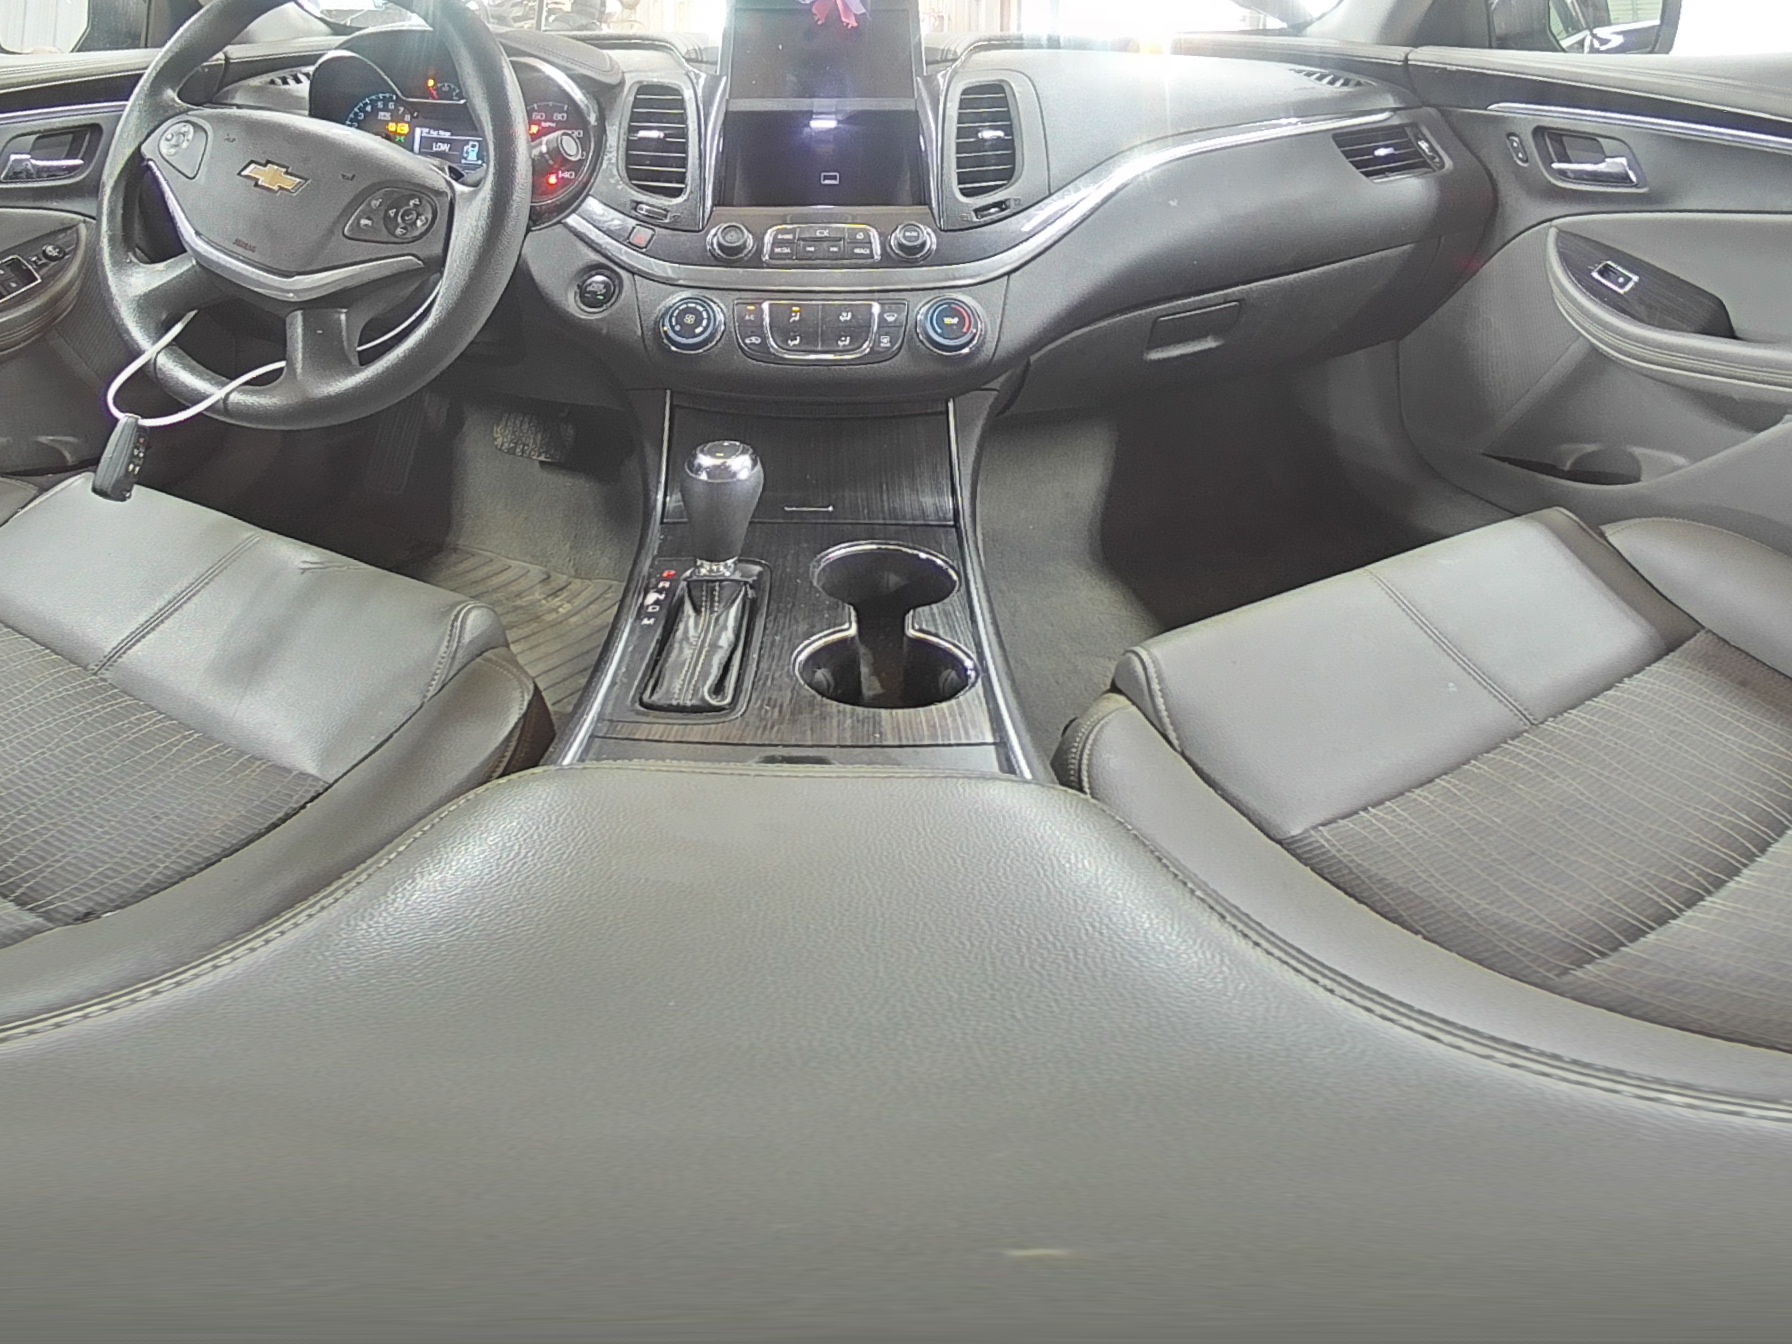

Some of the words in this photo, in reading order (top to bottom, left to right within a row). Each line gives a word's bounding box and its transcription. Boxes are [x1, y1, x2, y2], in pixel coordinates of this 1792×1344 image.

[553, 113, 567, 121] 80
[432, 142, 451, 152] LOW
[558, 170, 575, 179] 140
